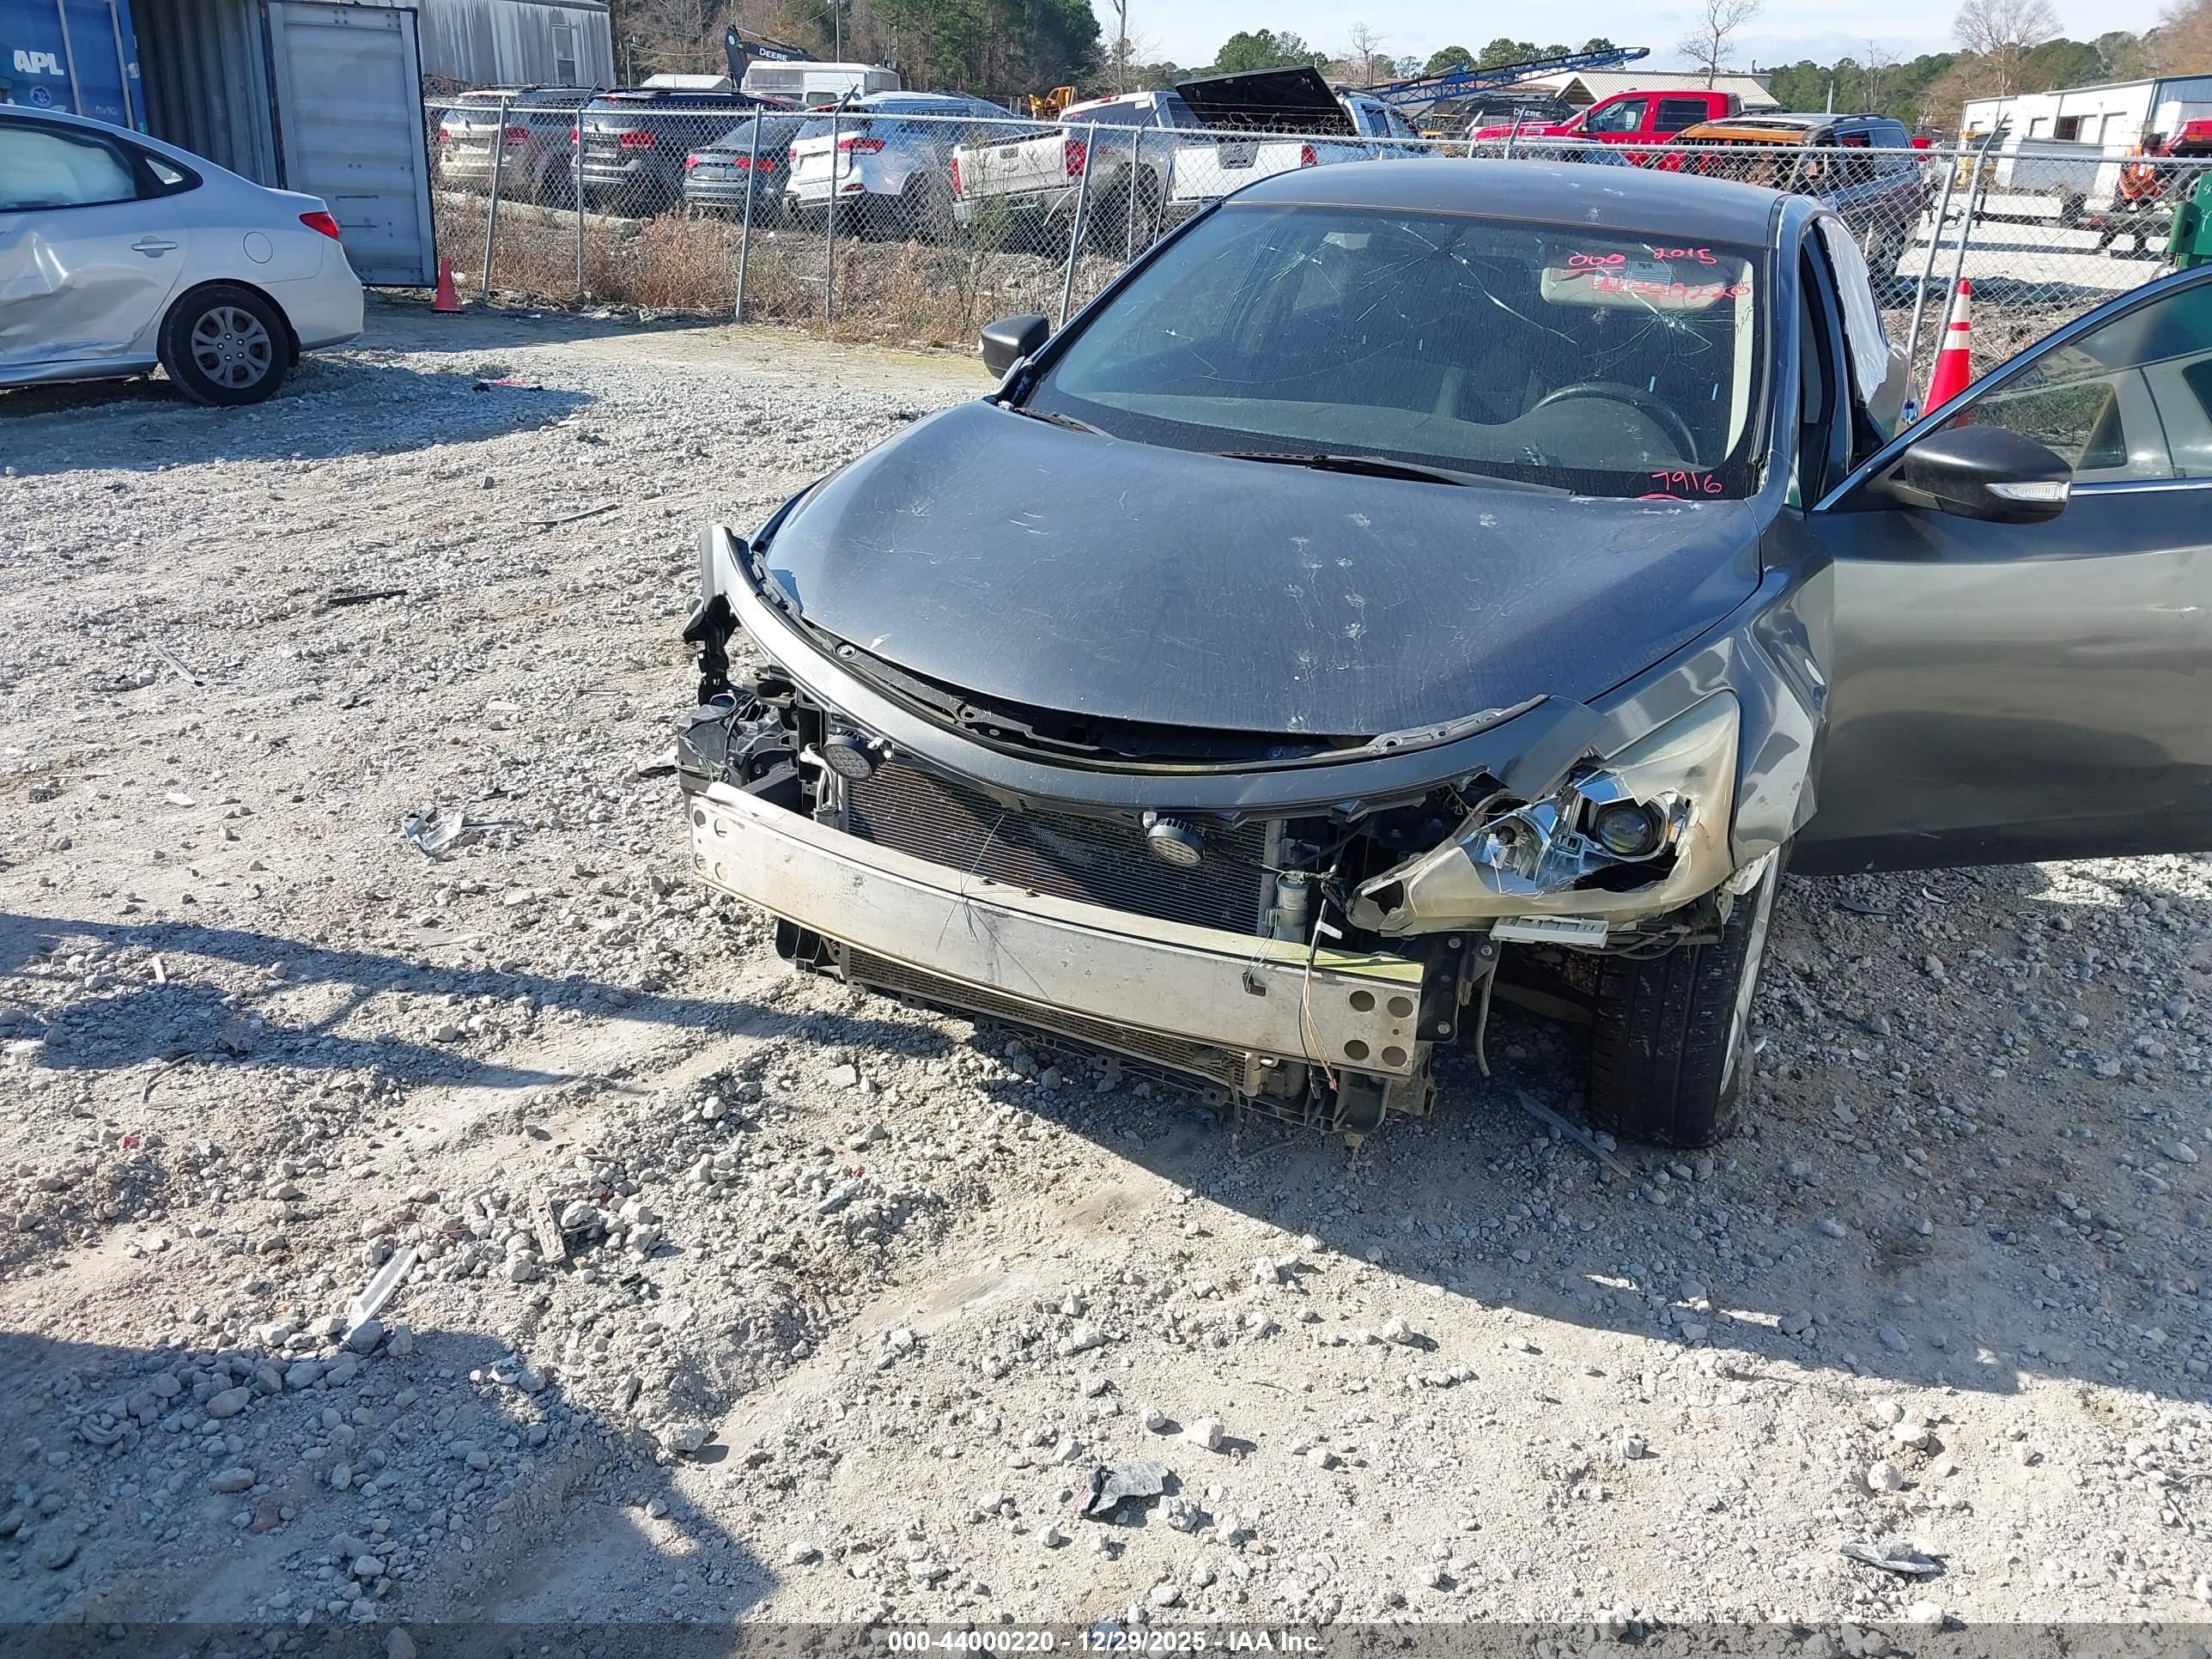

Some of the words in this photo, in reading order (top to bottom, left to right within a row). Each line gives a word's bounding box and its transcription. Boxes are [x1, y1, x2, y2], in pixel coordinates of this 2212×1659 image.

[14, 50, 64, 76] APL
[759, 47, 788, 61] DEERE
[1513, 108, 1541, 118] DERE
[1653, 247, 1717, 265] 2015
[1651, 471, 1723, 494] 7916
